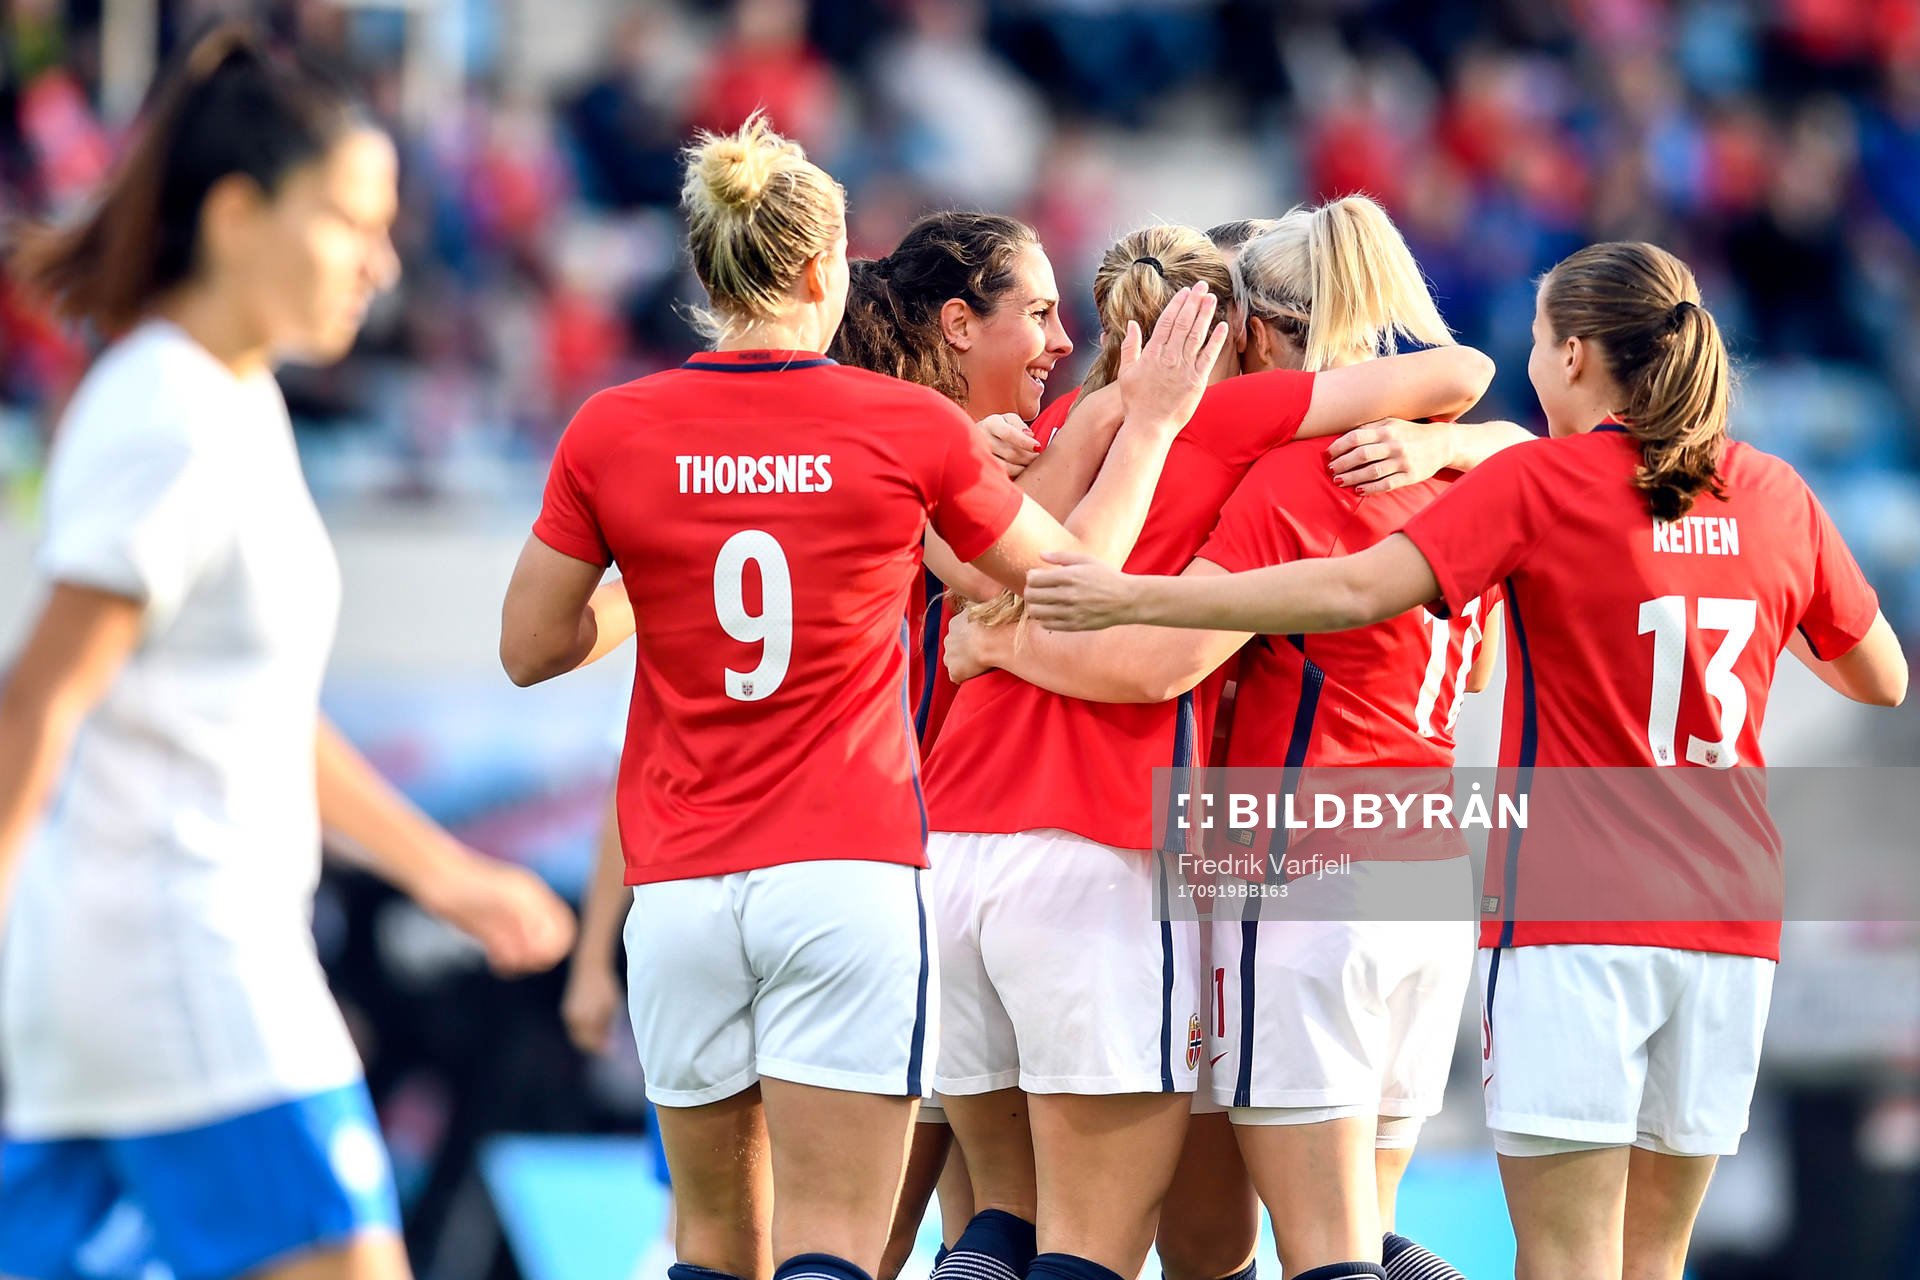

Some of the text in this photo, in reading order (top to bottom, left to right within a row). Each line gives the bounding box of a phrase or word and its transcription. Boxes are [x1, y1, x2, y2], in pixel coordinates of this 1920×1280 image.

[675, 454, 833, 493] THORSNES
[1652, 516, 1740, 556] REITEN
[713, 529, 793, 702] 9
[1414, 595, 1482, 738] 11
[1637, 595, 1757, 770] 13
